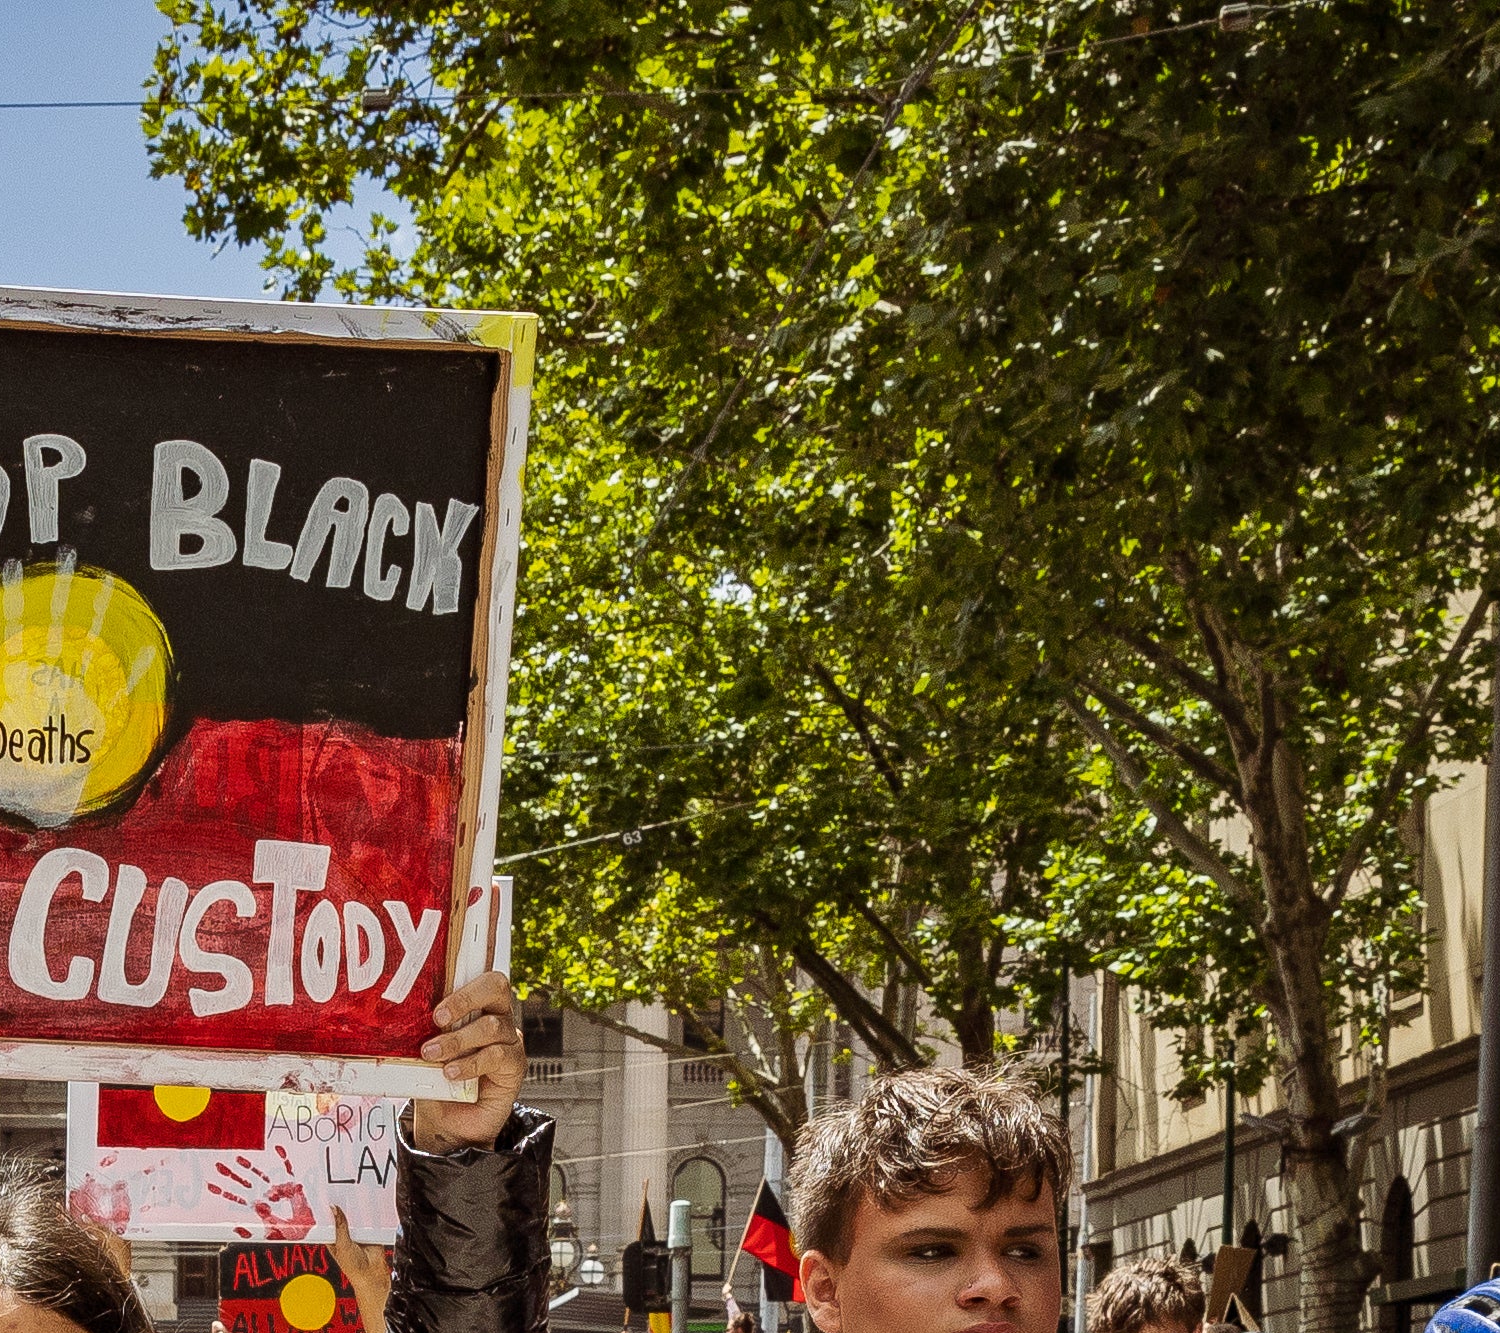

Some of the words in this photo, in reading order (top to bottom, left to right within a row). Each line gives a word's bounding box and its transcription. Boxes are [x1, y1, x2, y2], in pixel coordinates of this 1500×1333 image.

[150, 439, 480, 616] BLACK
[8, 840, 443, 1016] CUSTODY
[233, 1244, 329, 1291] ALWAYS
